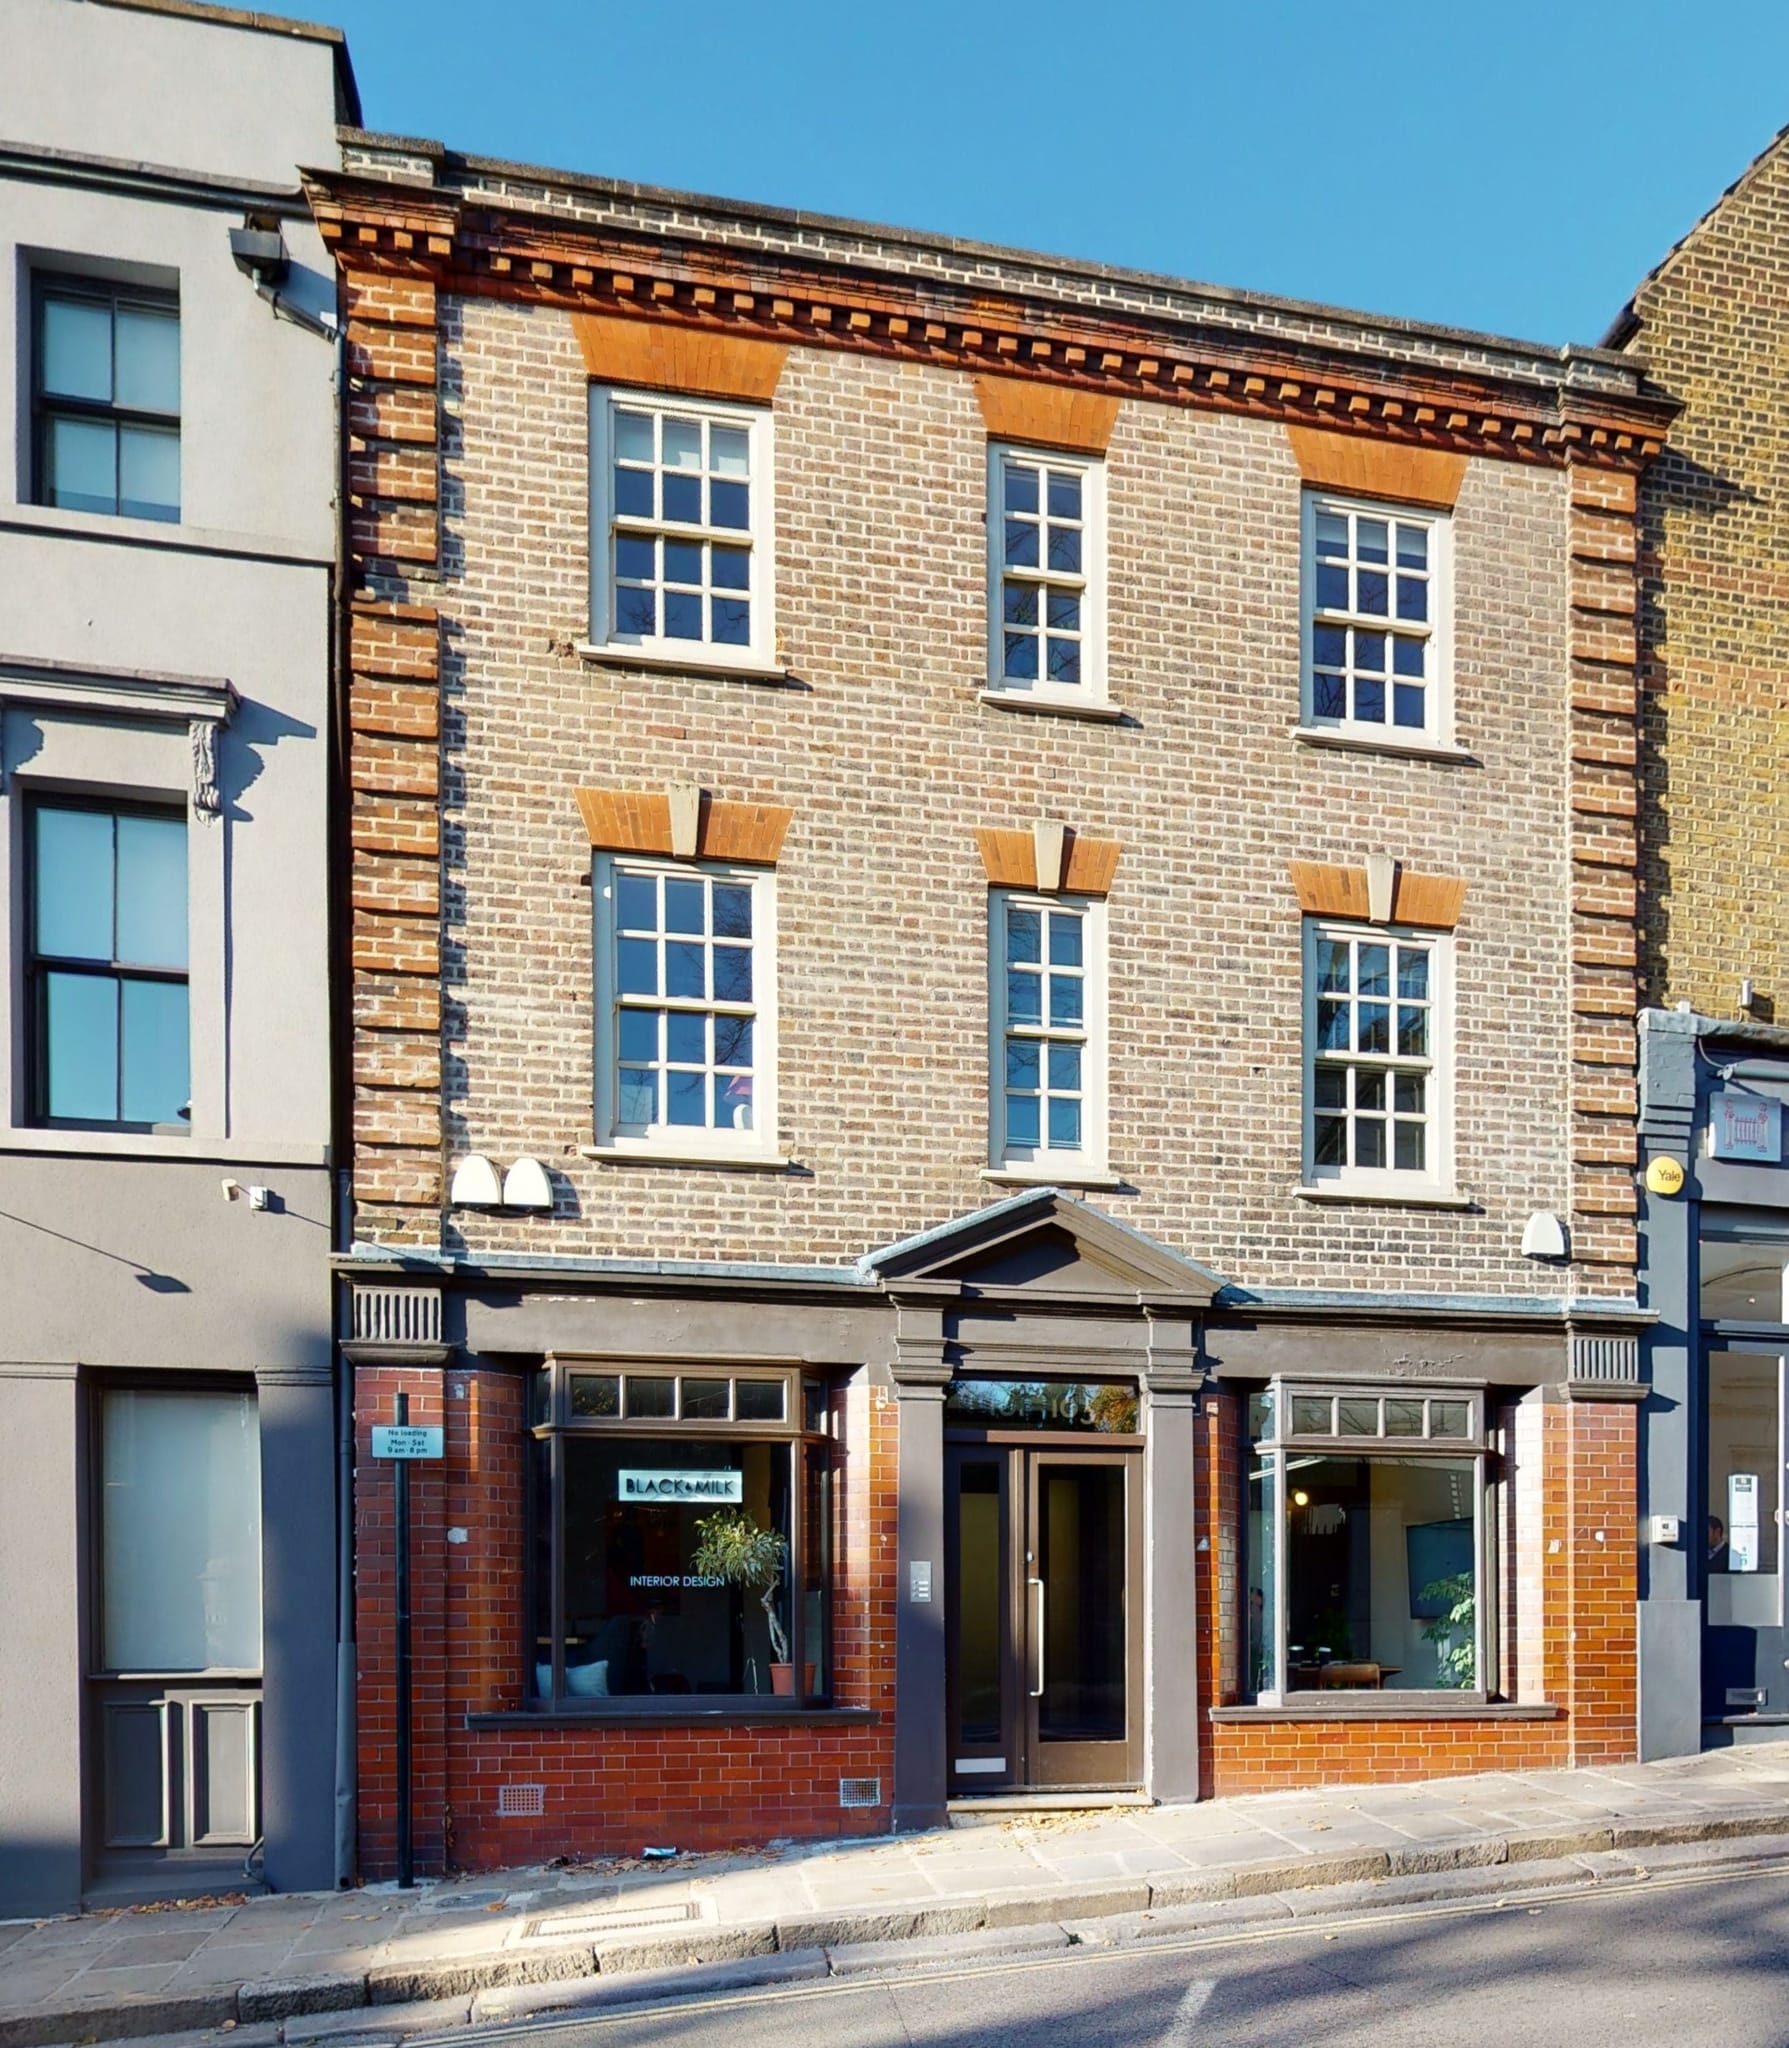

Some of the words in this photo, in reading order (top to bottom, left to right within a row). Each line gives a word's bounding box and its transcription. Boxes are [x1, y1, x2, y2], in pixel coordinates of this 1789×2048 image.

[1658, 1169, 1681, 1182] Yale
[388, 1429, 399, 1437] No
[401, 1429, 428, 1438] loading
[630, 1575, 680, 1587] INTERIOR
[682, 1575, 725, 1587] DESIGN
